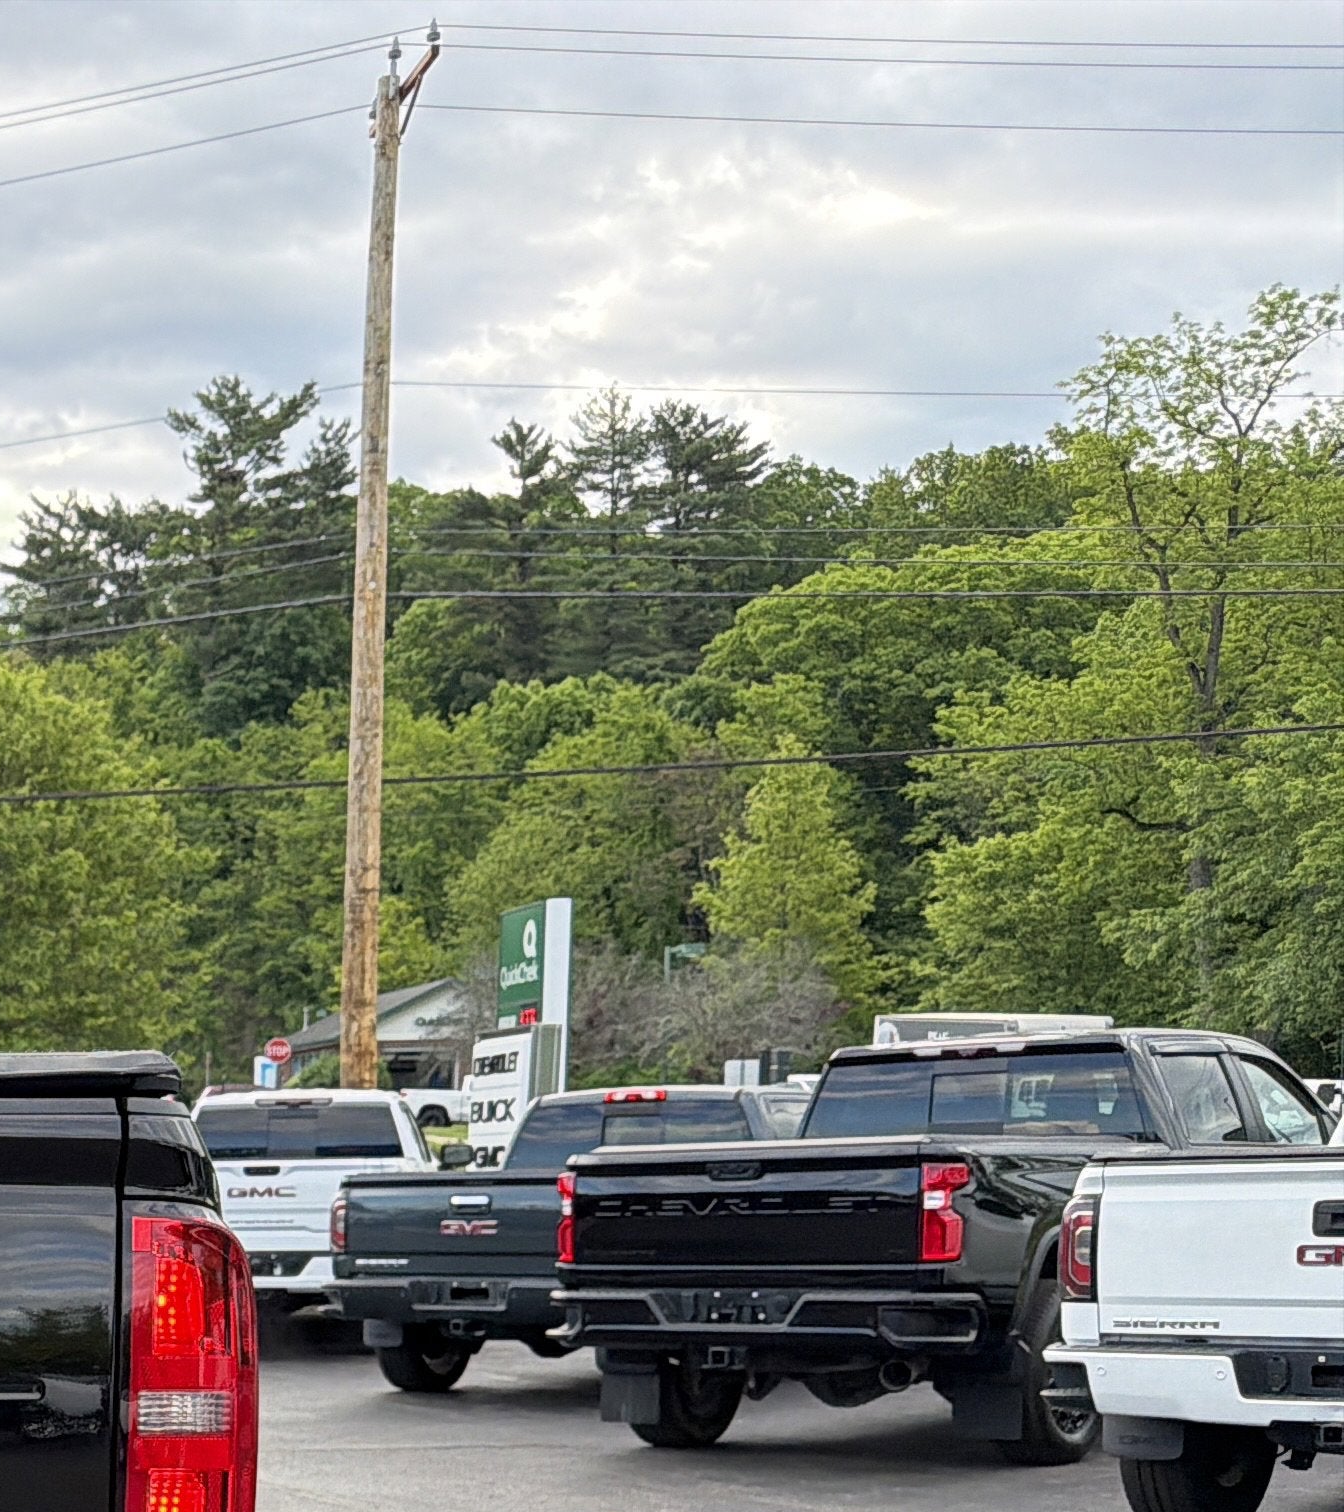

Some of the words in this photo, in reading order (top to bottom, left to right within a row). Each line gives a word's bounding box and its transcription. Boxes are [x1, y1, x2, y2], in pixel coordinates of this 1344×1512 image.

[265, 1047, 289, 1057] STOP
[471, 1098, 516, 1123] BUICK
[227, 1186, 297, 1199] GMC
[440, 1219, 499, 1236] GMC
[1113, 1318, 1221, 1330] SIERRA
